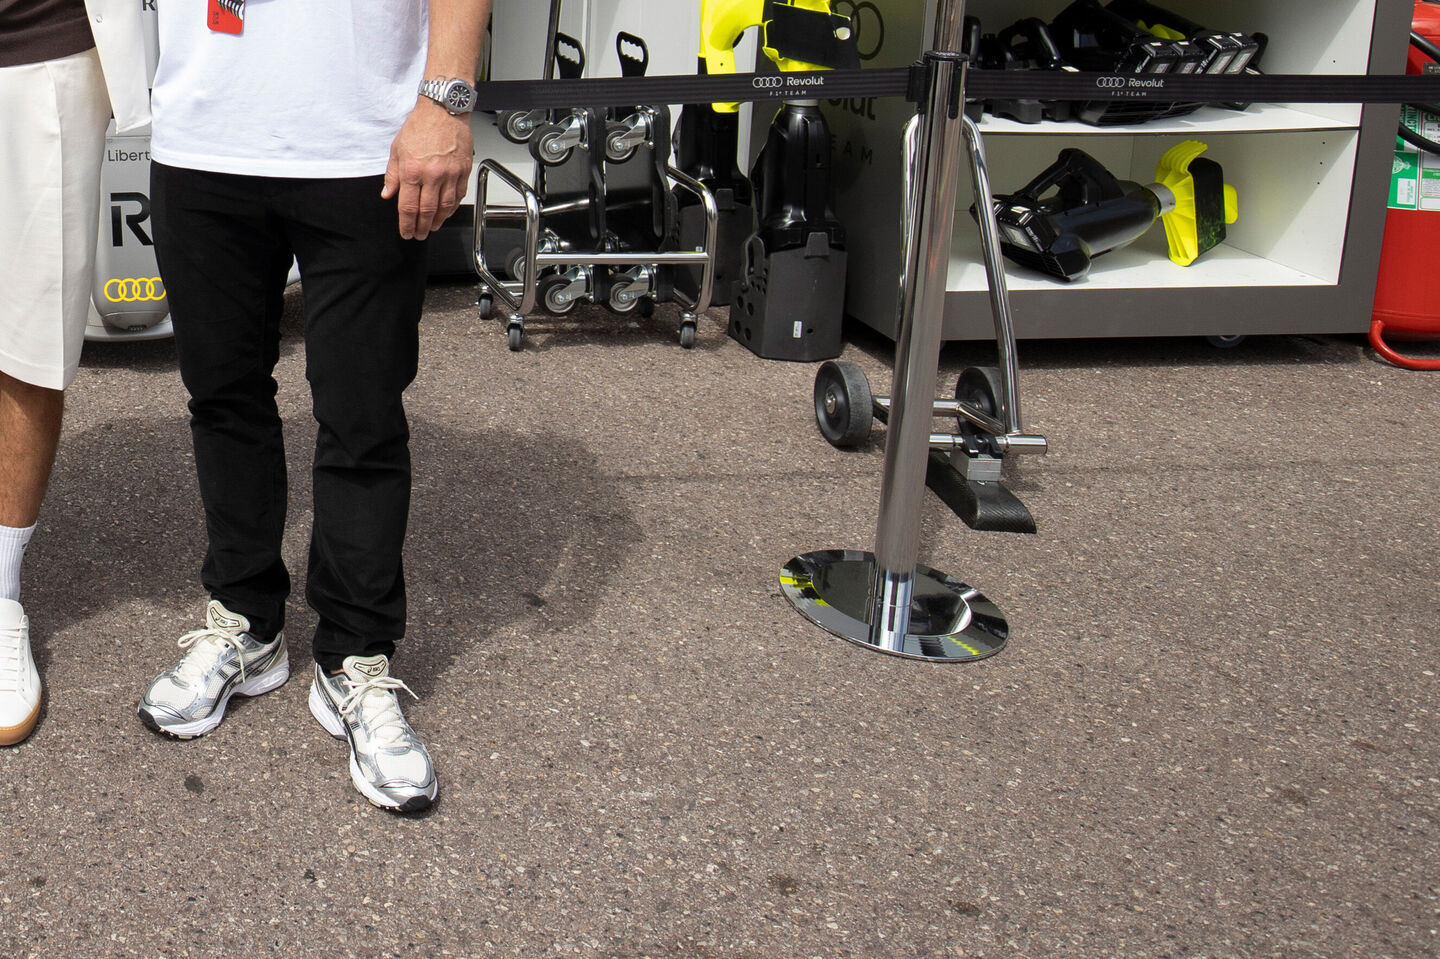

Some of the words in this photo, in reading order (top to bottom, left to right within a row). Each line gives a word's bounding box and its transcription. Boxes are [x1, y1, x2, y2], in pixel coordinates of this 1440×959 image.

[786, 76, 825, 86] Revolut
[1128, 78, 1164, 88] Revolut
[108, 149, 150, 162] Libert
